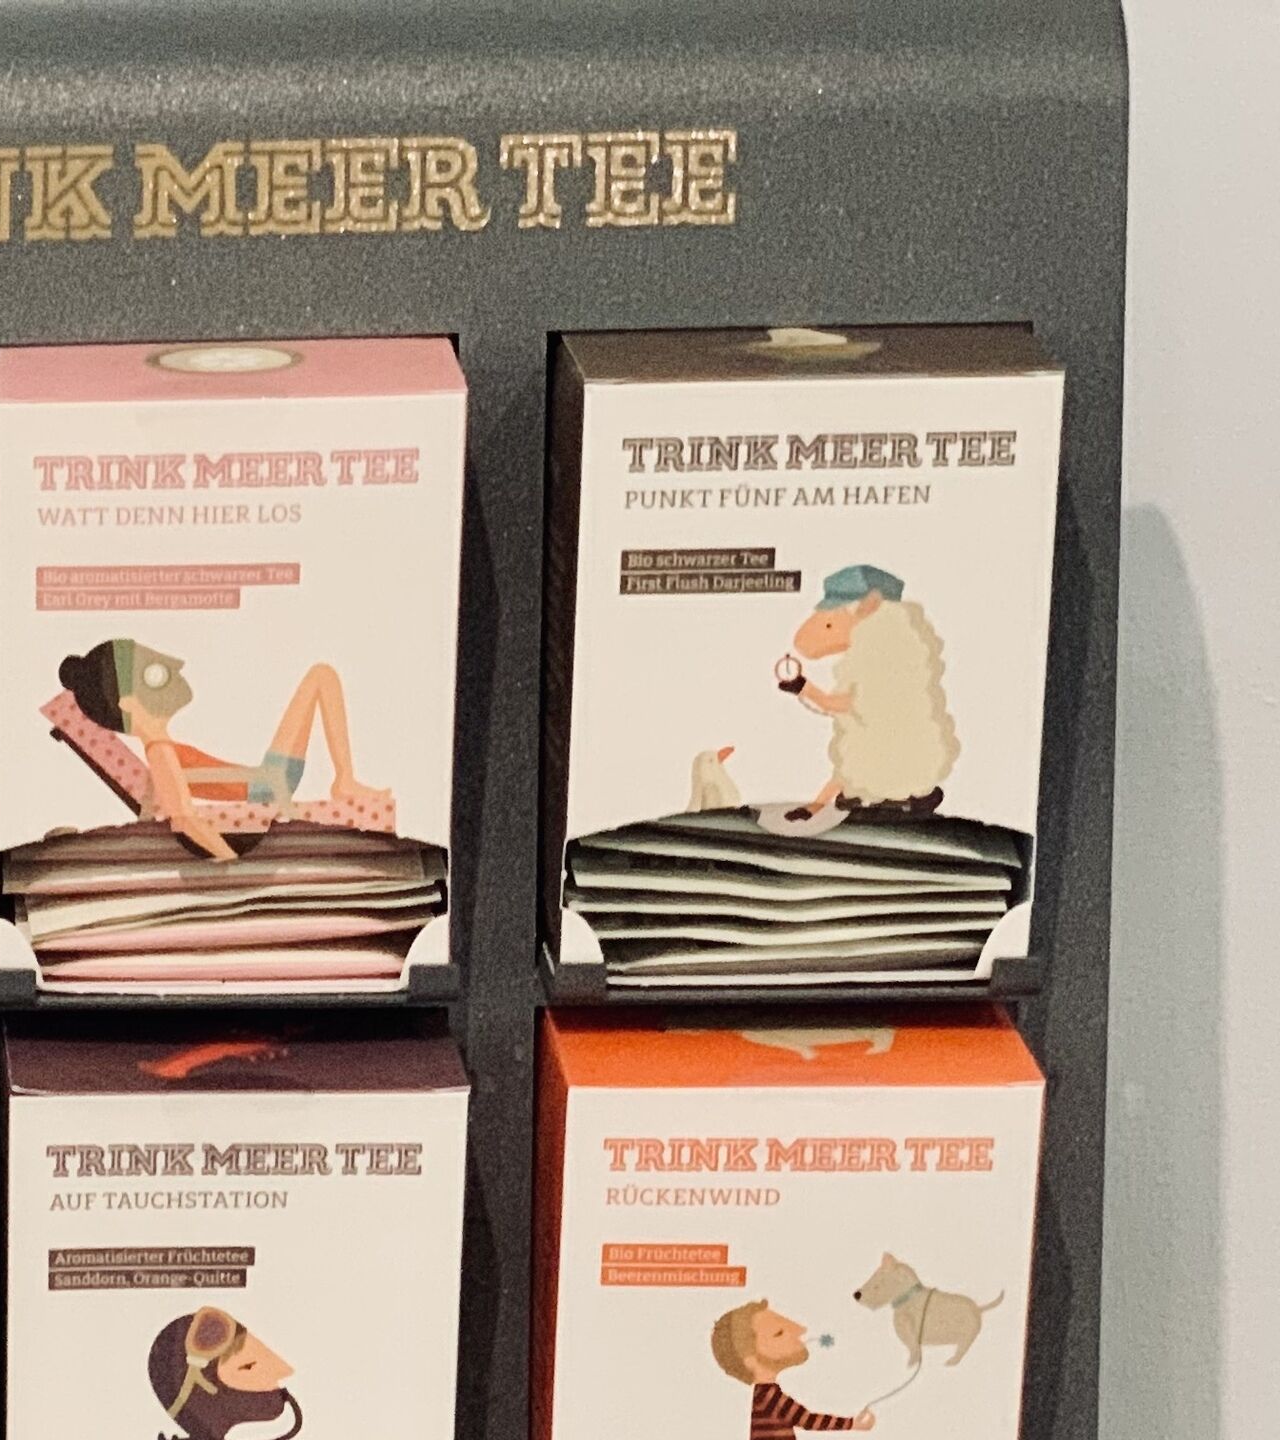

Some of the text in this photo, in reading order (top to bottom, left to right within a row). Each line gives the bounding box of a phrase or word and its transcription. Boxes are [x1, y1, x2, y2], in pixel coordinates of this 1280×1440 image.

[132, 135, 491, 239] MEER
[500, 129, 738, 231] TEE
[622, 430, 1017, 473] TRINK MEER TEE
[33, 448, 420, 490] TRINK MEER TEE
[624, 484, 932, 509] PUNKT FÜNF AM HAFEN
[38, 504, 302, 527] WATT DENN HIER LOS
[627, 552, 769, 568] Bio schwarzer Tee
[43, 569, 67, 585] Bio
[268, 566, 293, 582] Tee
[627, 574, 795, 593] First Flush Darjeeling
[47, 1143, 423, 1177] TRINK MEER TEE
[603, 1137, 995, 1173] TRINK MEER TEE
[50, 1191, 288, 1211] AUF TAUCHSTATION
[606, 1184, 781, 1207] RÜCKENWIND
[55, 1249, 249, 1265] Aromatisierter Früchtetee
[609, 1247, 722, 1261] Bio Früchtetee
[608, 1269, 741, 1285] Beerenmischung
